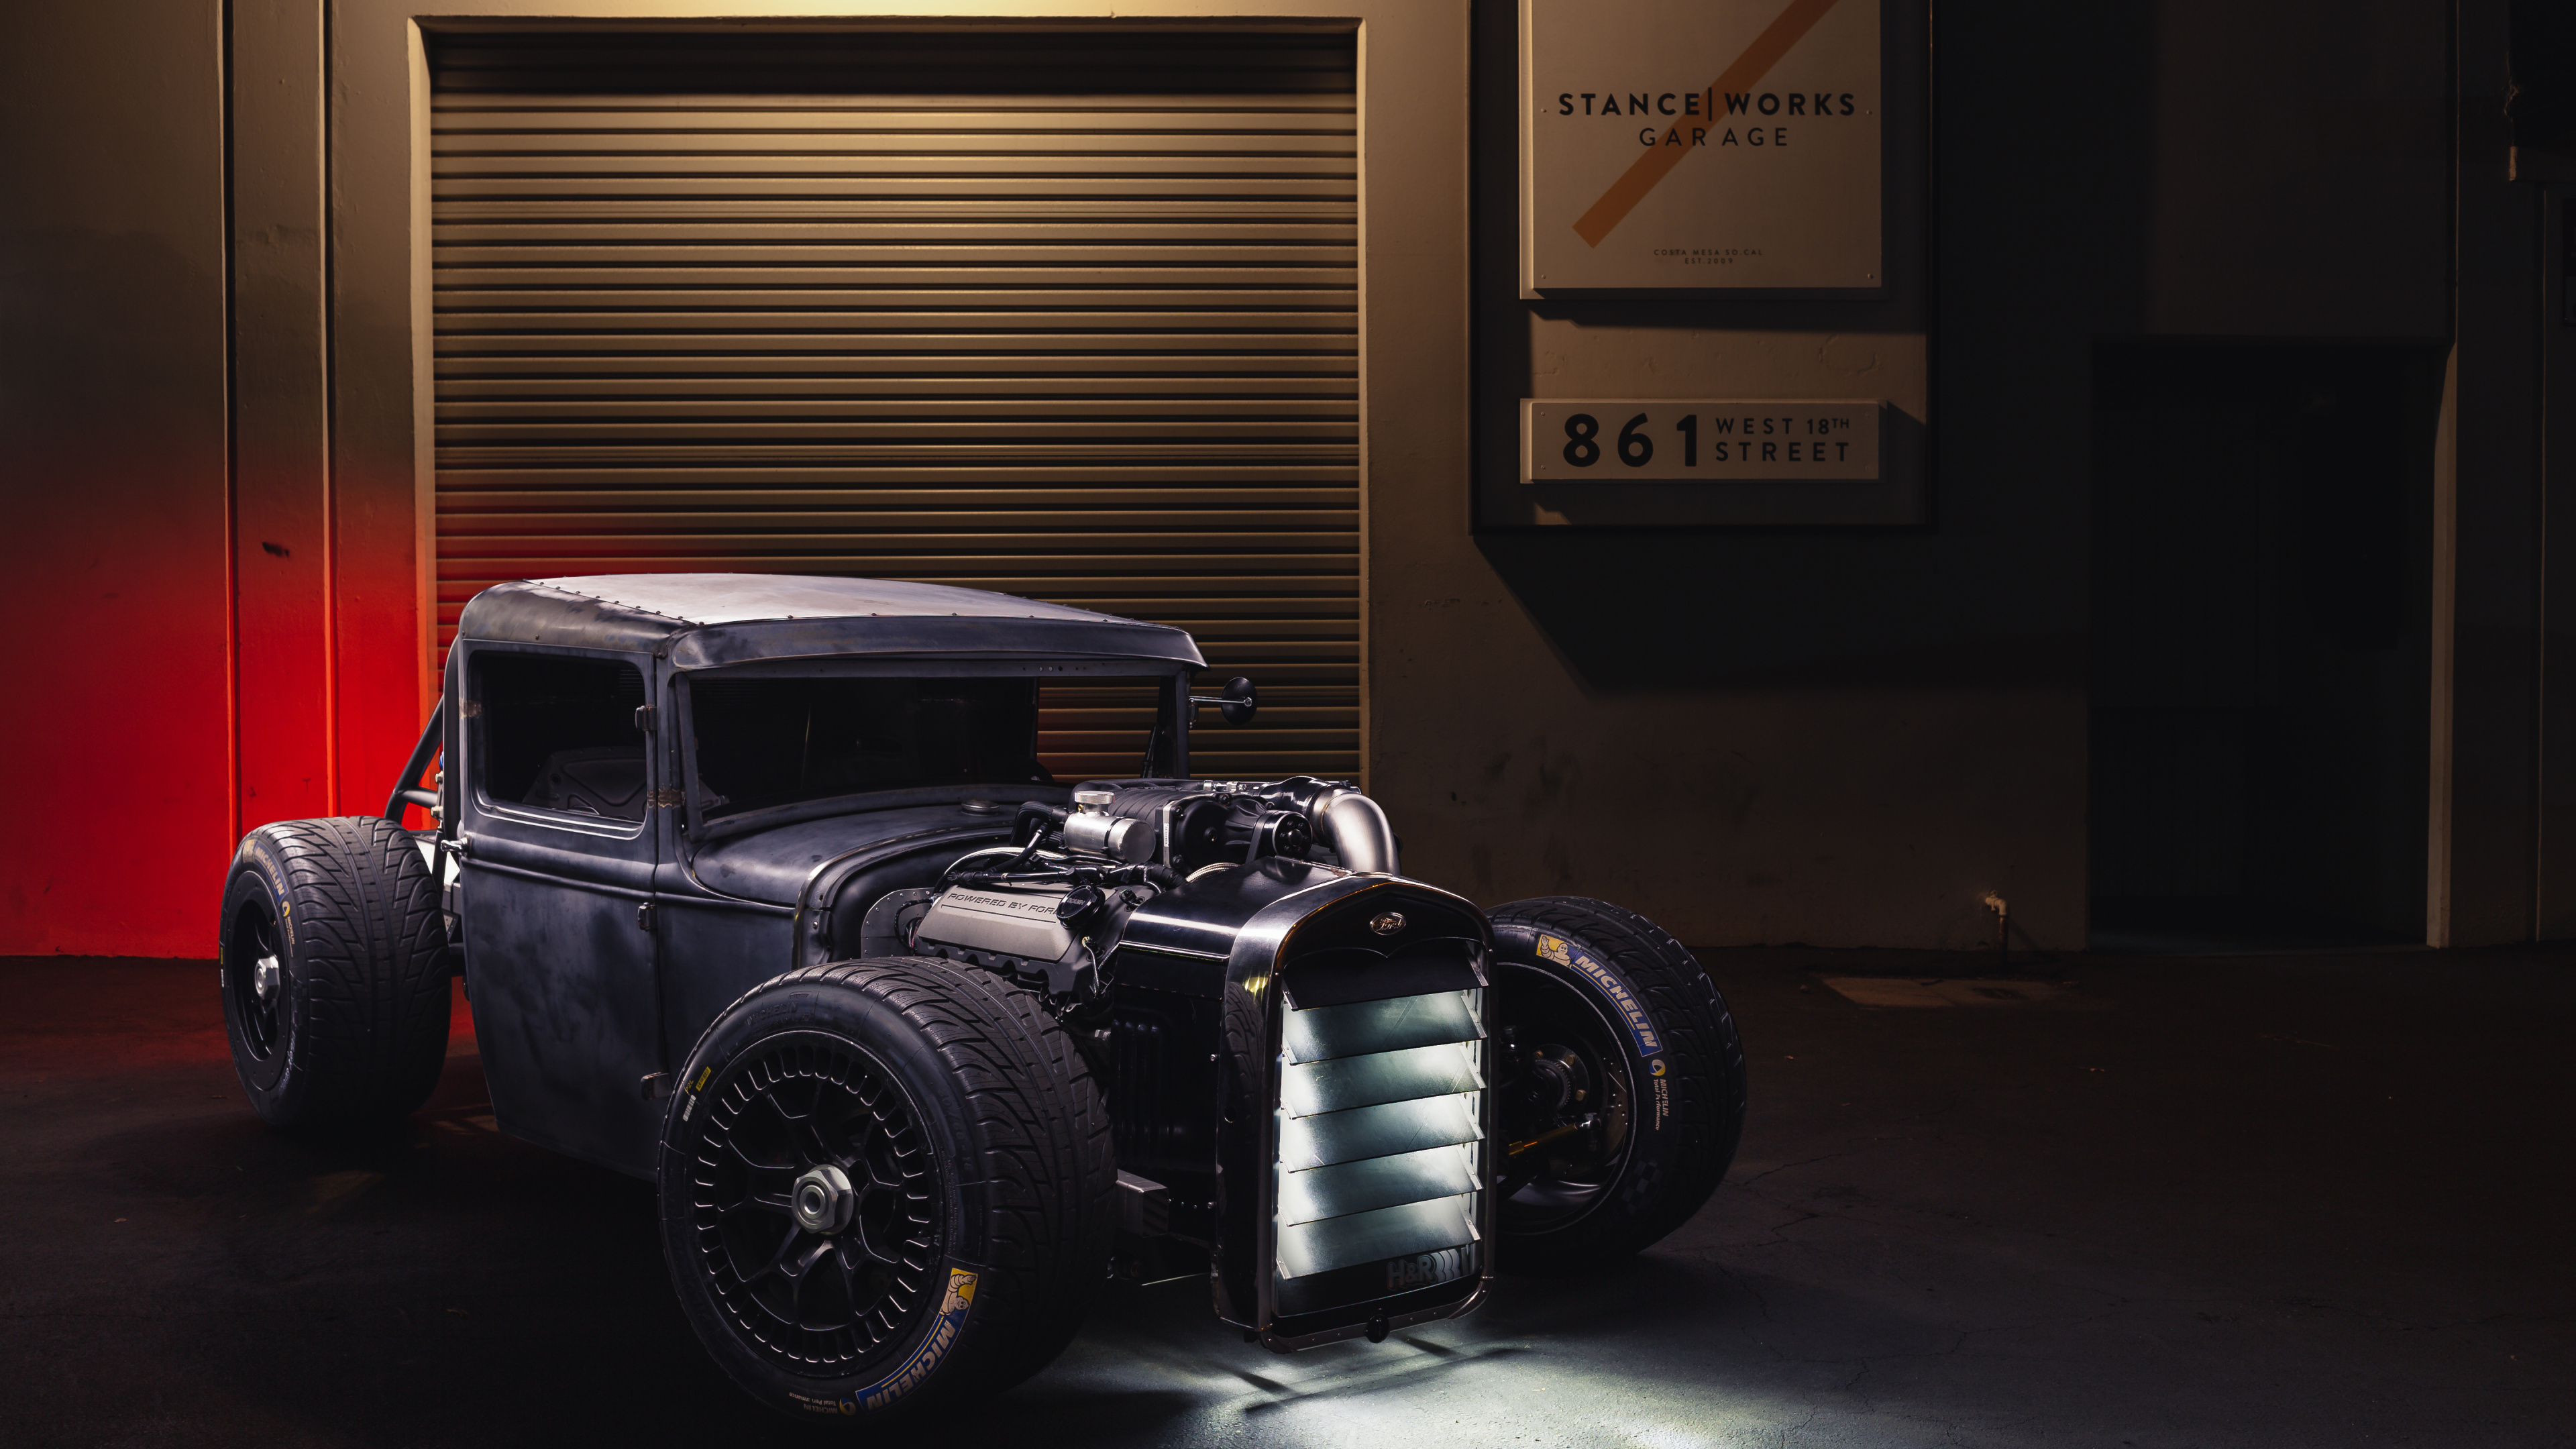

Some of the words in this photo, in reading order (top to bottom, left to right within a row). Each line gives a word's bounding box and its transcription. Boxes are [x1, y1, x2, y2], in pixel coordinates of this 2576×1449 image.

[1639, 127, 1788, 147] GARAGE
[1563, 413, 1697, 468] 861
[1715, 417, 1794, 435] WEST
[1807, 417, 1850, 435] 18TH
[1715, 441, 1850, 462] STREET
[256, 846, 284, 896] MICHELIN
[947, 893, 1008, 907] POWERED
[1008, 902, 1028, 910] BY
[1028, 905, 1057, 915] FOR
[1574, 955, 1658, 1048] MICHELIN
[1660, 1079, 1669, 1117] MICHELIN
[1388, 1255, 1436, 1289] H&R
[867, 1320, 956, 1410] MICHELIN
[803, 1403, 838, 1414] MICHELIN
